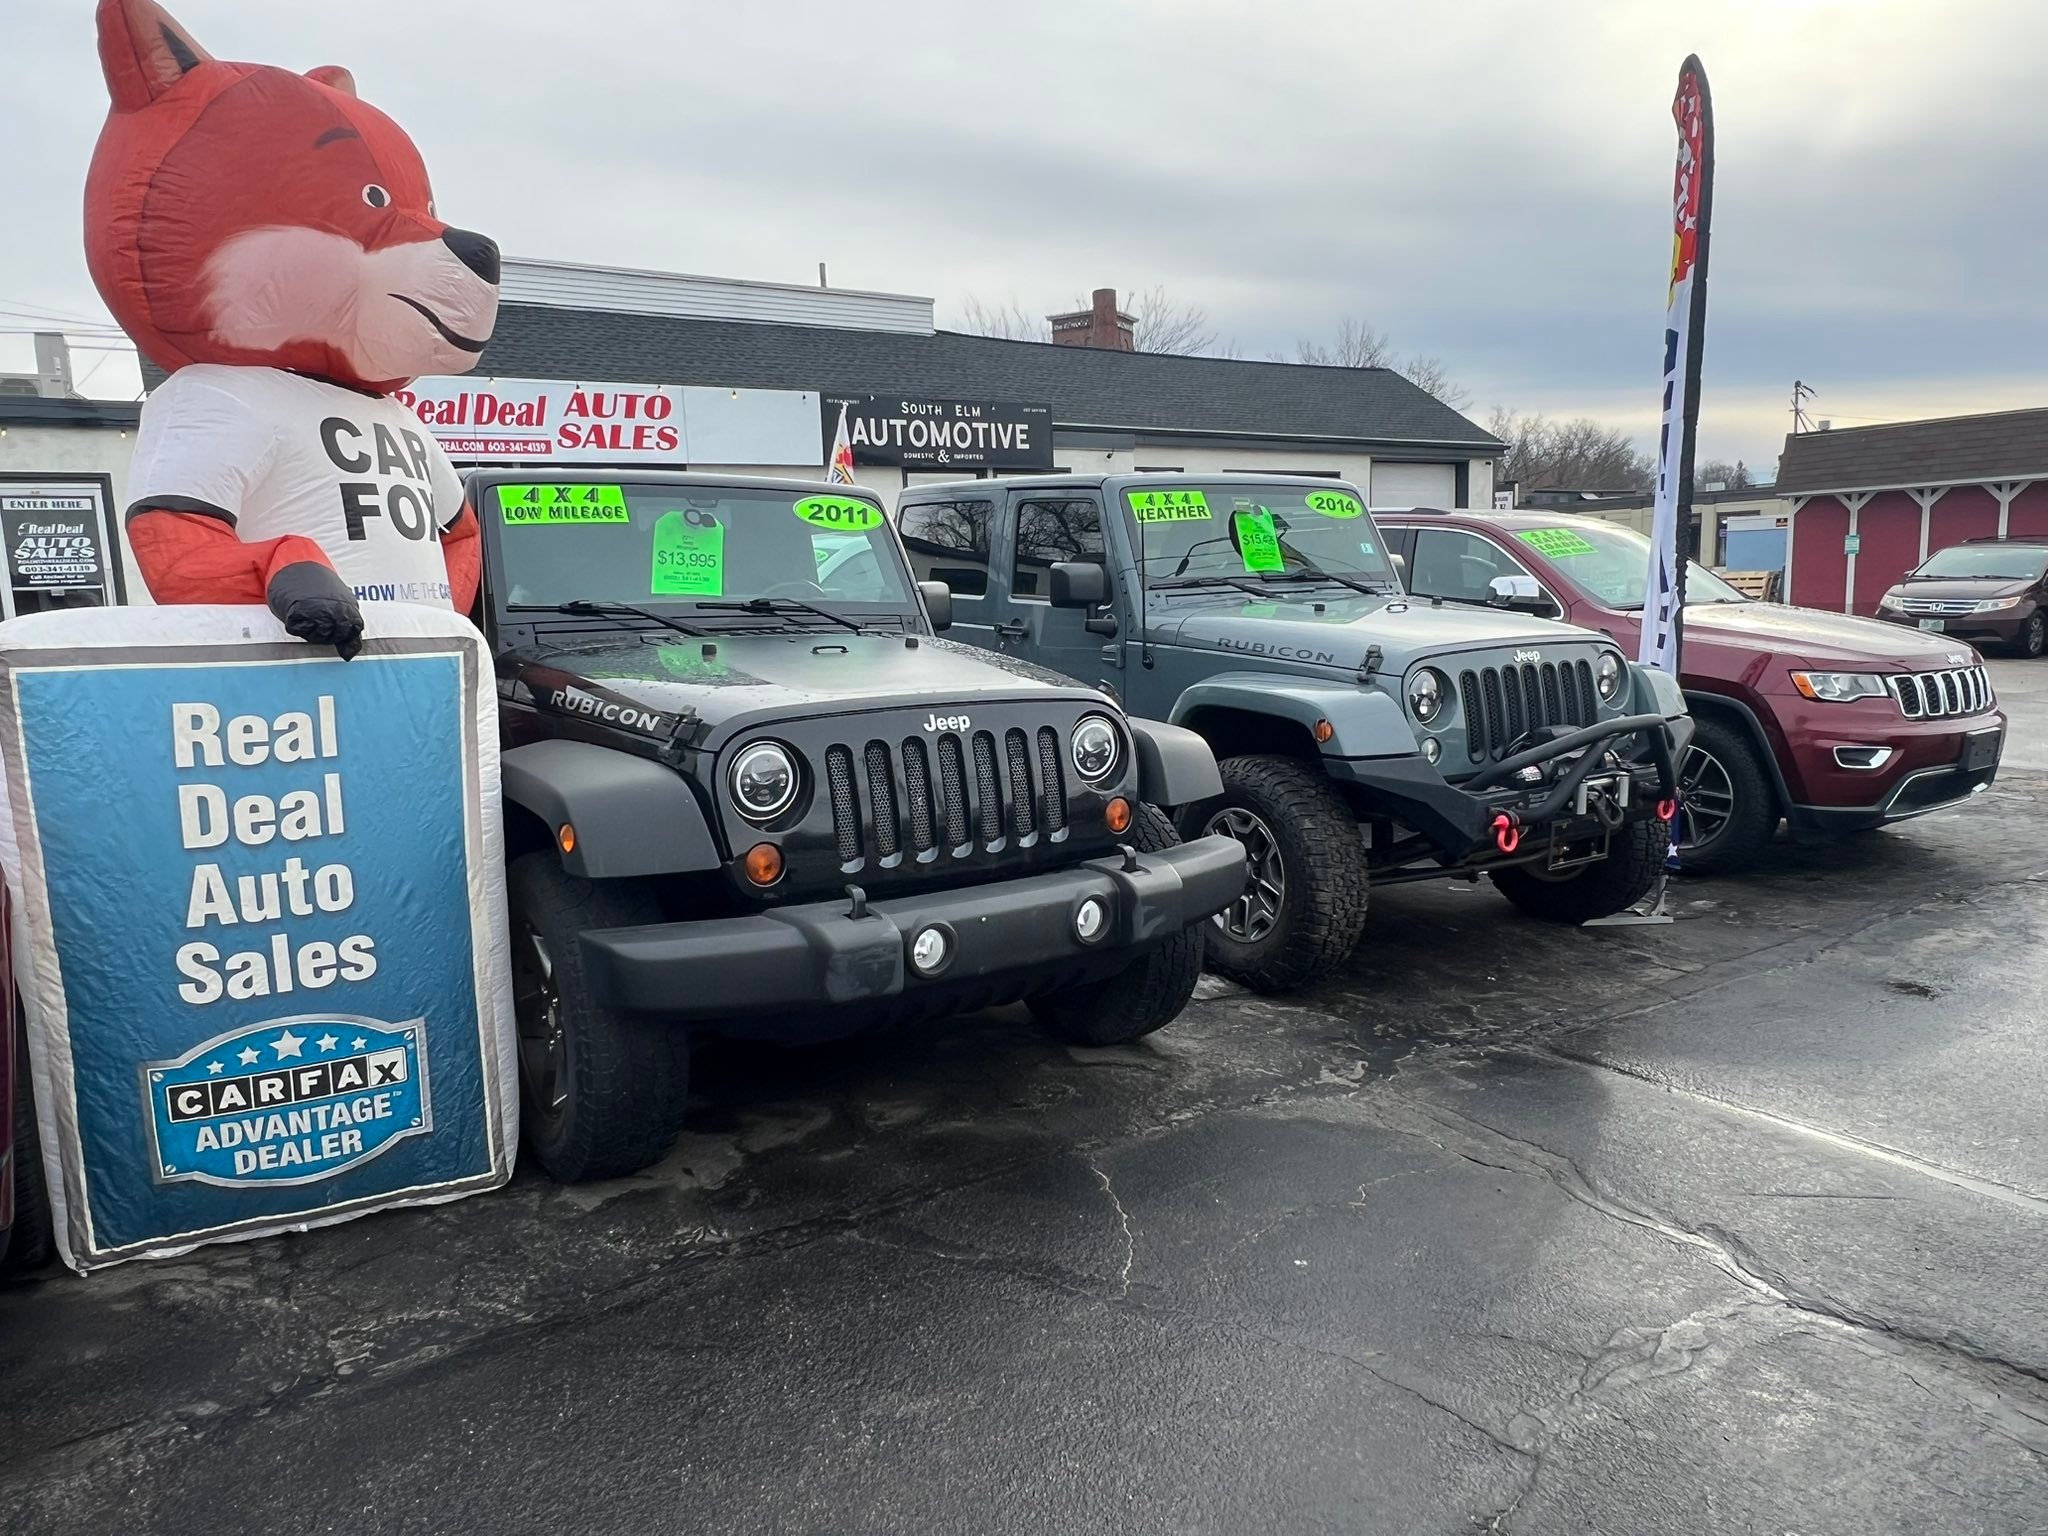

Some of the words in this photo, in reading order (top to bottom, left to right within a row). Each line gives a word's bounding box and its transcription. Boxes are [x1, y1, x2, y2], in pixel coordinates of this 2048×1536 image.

[473, 393, 547, 427] Deal
[563, 391, 672, 420] AUTO
[901, 401, 943, 416] SOUTH
[955, 404, 981, 417] ELM
[556, 423, 679, 451] SALES
[851, 417, 1030, 450] AUTOMOTIVE
[319, 416, 433, 486] CAR
[487, 441, 546, 454] 603-341-4139
[904, 452, 935, 460] DOMESTIC
[937, 450, 951, 463] &
[10, 501, 48, 509] ENTER
[52, 501, 84, 509] HERE
[523, 487, 540, 504] 4
[553, 487, 572, 504] X
[583, 487, 600, 504] 4
[1145, 493, 1156, 507] 4
[1163, 493, 1176, 506] X
[1181, 493, 1192, 506] 4
[1314, 496, 1357, 514] 2014
[505, 506, 543, 521] LOW
[548, 505, 625, 520] MILEAGE
[807, 503, 870, 526] 2011
[1136, 506, 1209, 521] LEATHER
[28, 524, 56, 535] Real
[57, 524, 85, 534] Deal
[19, 537, 92, 549] AUTO
[14, 547, 96, 559] SALES
[658, 550, 718, 569] $13,995
[353, 584, 395, 601] HOW
[399, 583, 419, 600] ME
[420, 582, 439, 600] THE
[1217, 638, 1335, 663] RUBICON
[1513, 650, 1541, 663] Jeep
[550, 690, 661, 732] RUBICON
[172, 695, 338, 768] Real
[923, 714, 971, 733] Jeep
[178, 773, 345, 849] Deal
[186, 857, 354, 928] Auto
[176, 933, 377, 1004] Sales
[177, 1061, 402, 1115] CARFAX
[196, 1092, 393, 1153] ADVANTAGE
[233, 1129, 363, 1176] DEALER
